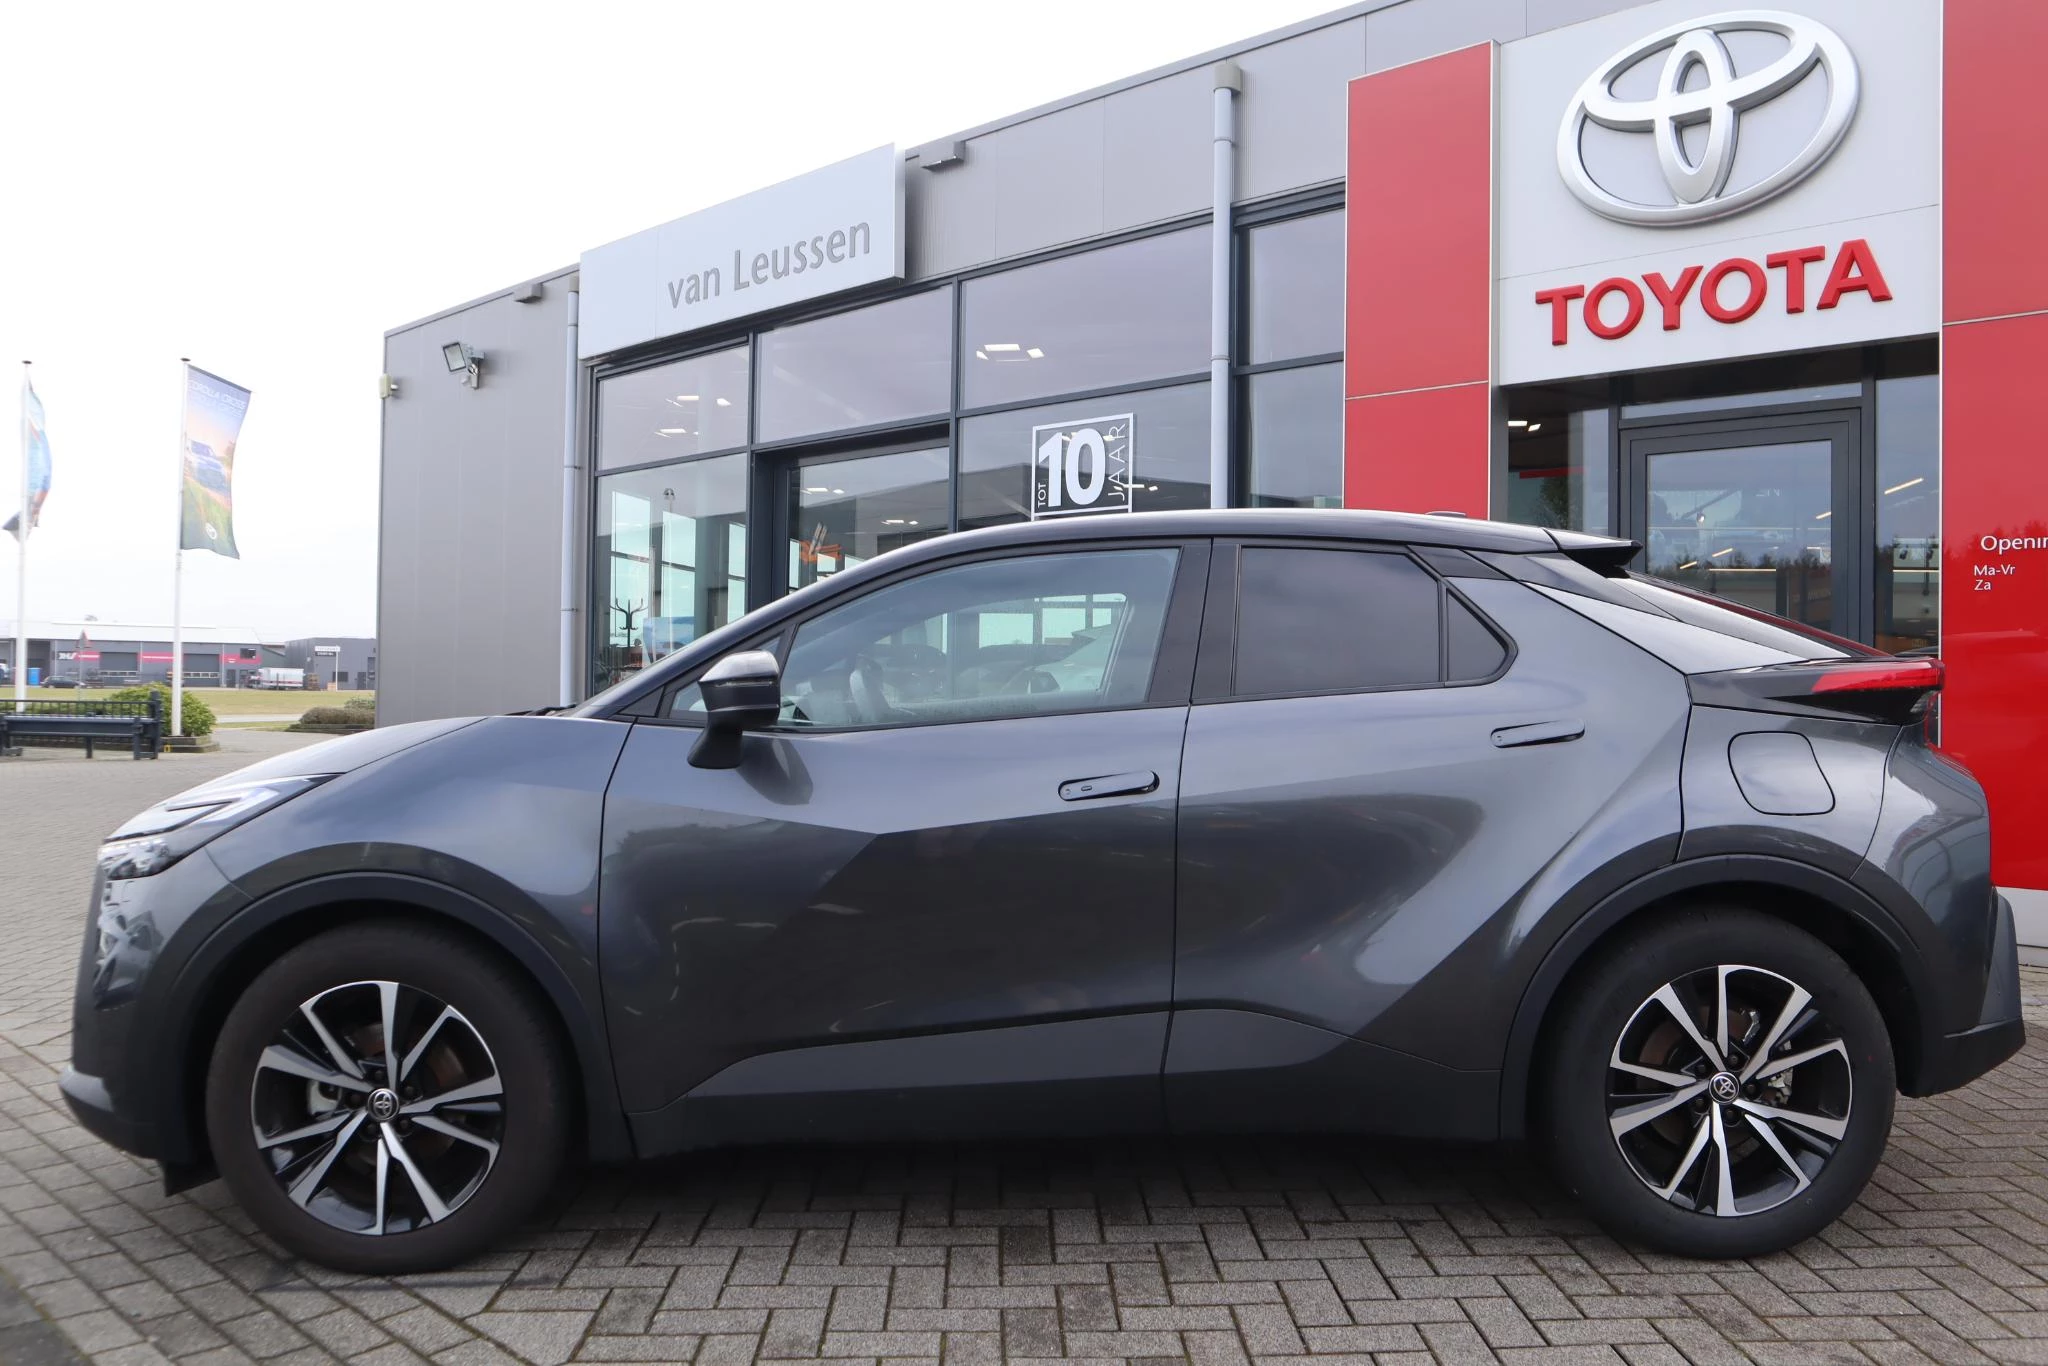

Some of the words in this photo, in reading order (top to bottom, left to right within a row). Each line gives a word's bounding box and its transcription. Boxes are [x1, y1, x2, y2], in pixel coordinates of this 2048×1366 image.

[668, 267, 721, 309] van
[734, 222, 870, 290] Leussen
[1535, 239, 1893, 346] TOYOTA
[1037, 483, 1047, 508] TOT
[1038, 428, 1106, 508] 10
[1108, 423, 1126, 501] JAAR
[1973, 564, 2016, 577] Ma-Vr
[1974, 579, 1992, 592] Za
